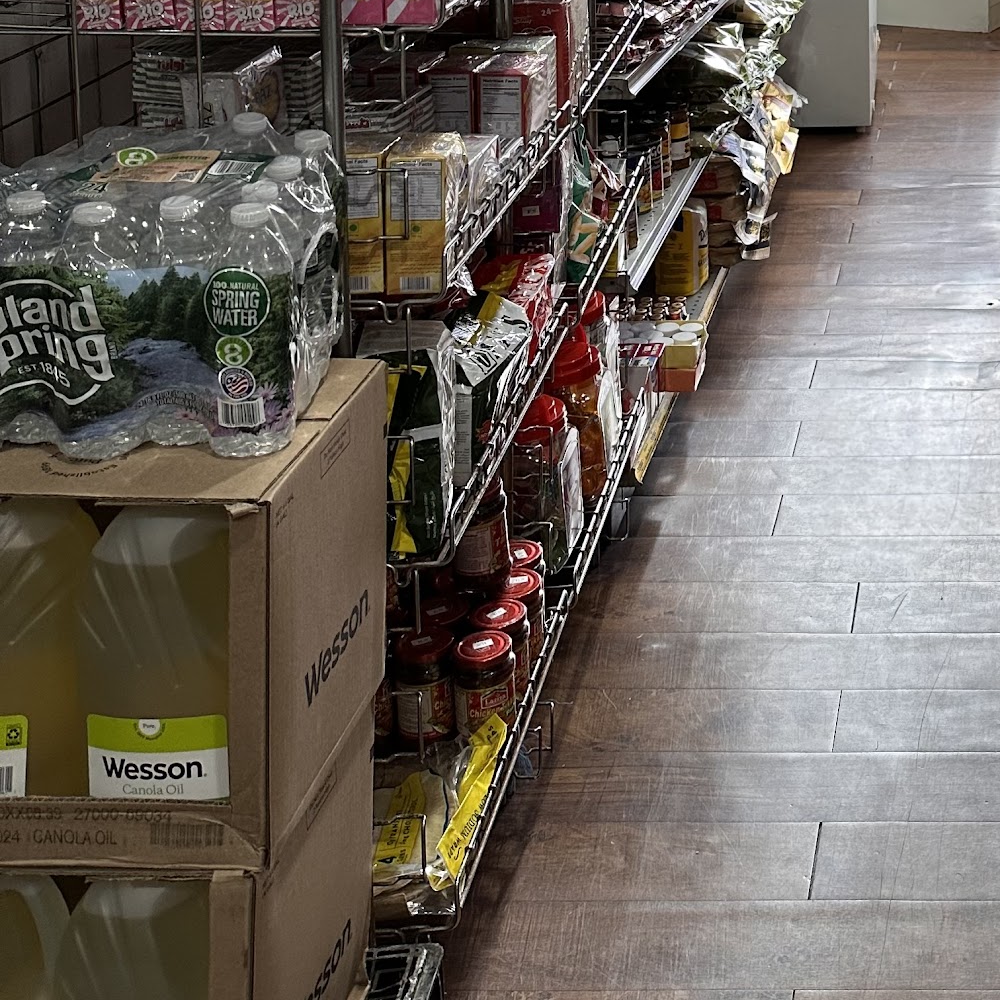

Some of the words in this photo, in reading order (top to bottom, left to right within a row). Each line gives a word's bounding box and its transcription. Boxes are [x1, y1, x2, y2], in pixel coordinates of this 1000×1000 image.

[83, 3, 112, 20] RIO
[138, 1, 164, 20] RIO
[237, 4, 265, 21] RIO
[287, 1, 315, 19] RIO
[230, 282, 259, 290] NATURAL
[0, 285, 106, 332] land
[212, 289, 260, 309] SPRING
[213, 307, 258, 326] WATER
[0, 323, 116, 382] pring
[18, 363, 38, 375] EST
[40, 361, 71, 388] 1845
[305, 589, 370, 708] Wesson
[102, 755, 203, 780] Wesson
[122, 784, 164, 796] Canola
[166, 784, 184, 795] Oil
[33, 830, 92, 845] CANOLA
[95, 830, 118, 845] OIL
